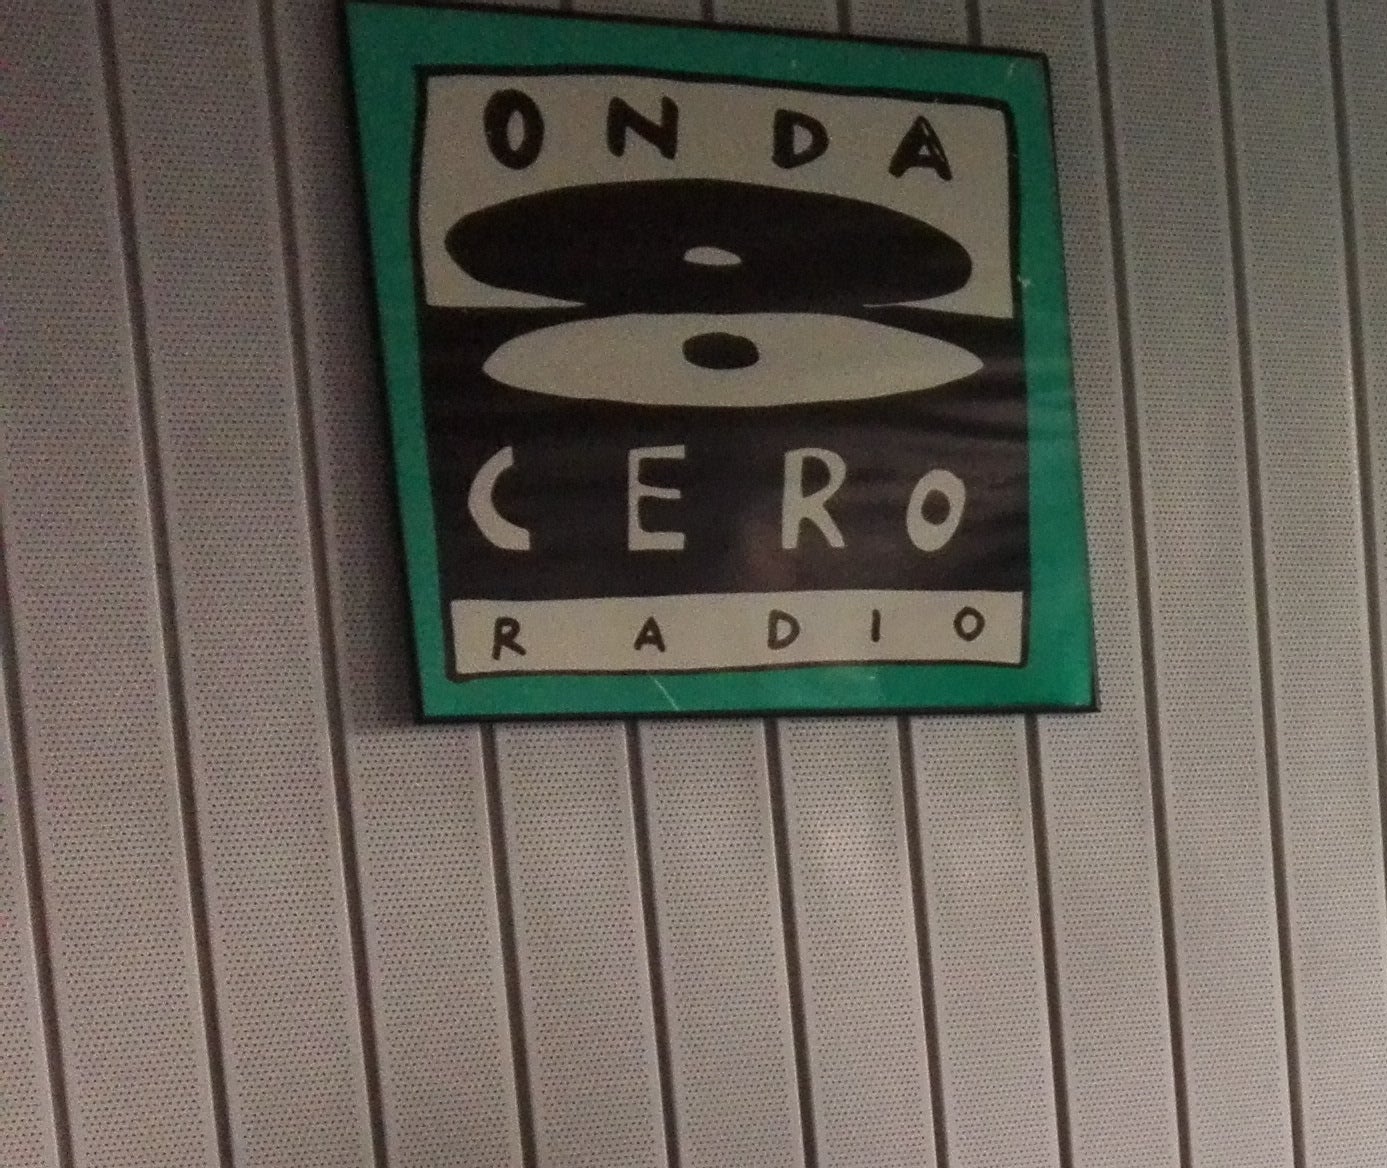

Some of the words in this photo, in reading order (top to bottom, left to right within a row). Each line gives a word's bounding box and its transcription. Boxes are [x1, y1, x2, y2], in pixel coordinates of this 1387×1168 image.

[483, 88, 953, 182] ONDA
[467, 444, 967, 553] CERO
[491, 606, 986, 660] RADIO
